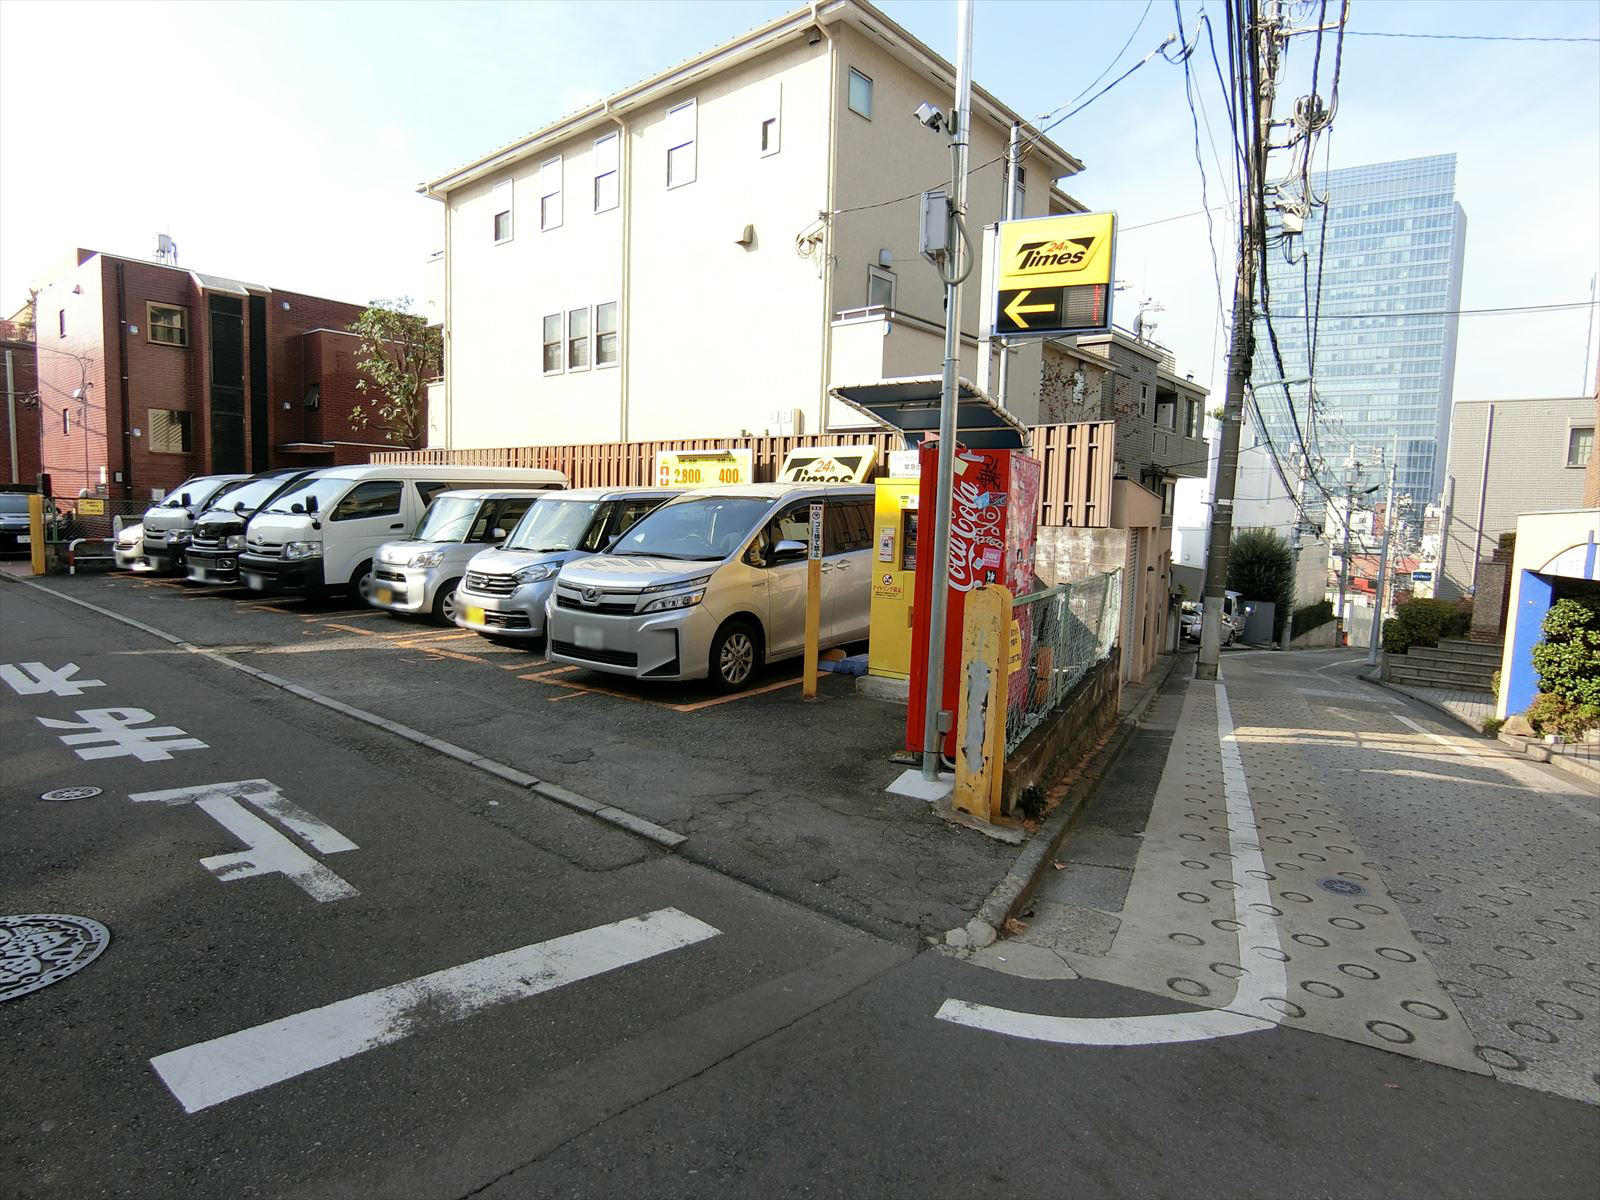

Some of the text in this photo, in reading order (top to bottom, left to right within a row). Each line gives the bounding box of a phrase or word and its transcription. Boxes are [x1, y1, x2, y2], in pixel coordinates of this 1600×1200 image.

[1047, 241, 1069, 252] 24h
[1016, 245, 1086, 270] Times
[815, 460, 836, 473] 24h
